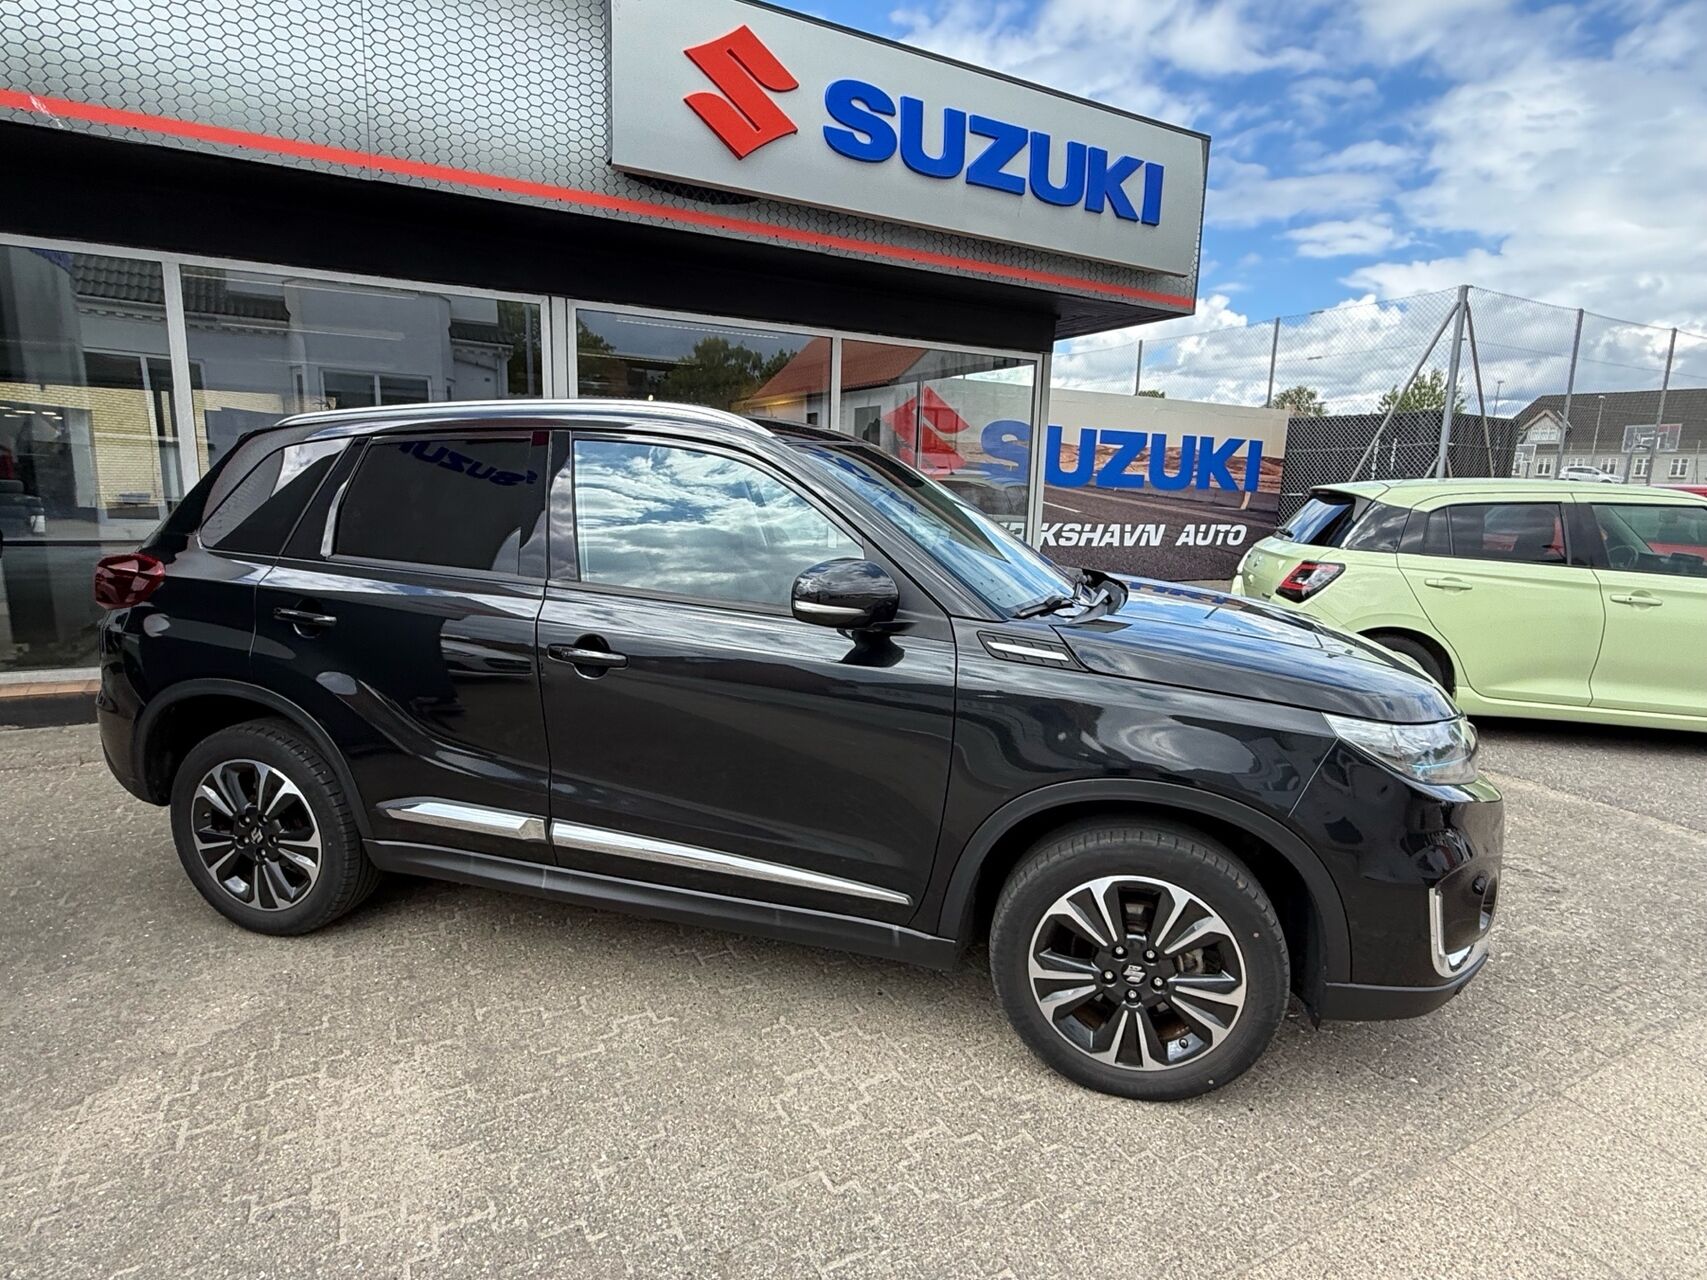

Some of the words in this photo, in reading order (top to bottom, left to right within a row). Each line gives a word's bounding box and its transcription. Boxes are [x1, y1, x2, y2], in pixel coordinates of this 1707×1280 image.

[823, 79, 1164, 226] SUZUKI
[980, 419, 1263, 493] SUZUKI
[1176, 524, 1247, 546] AUTO
